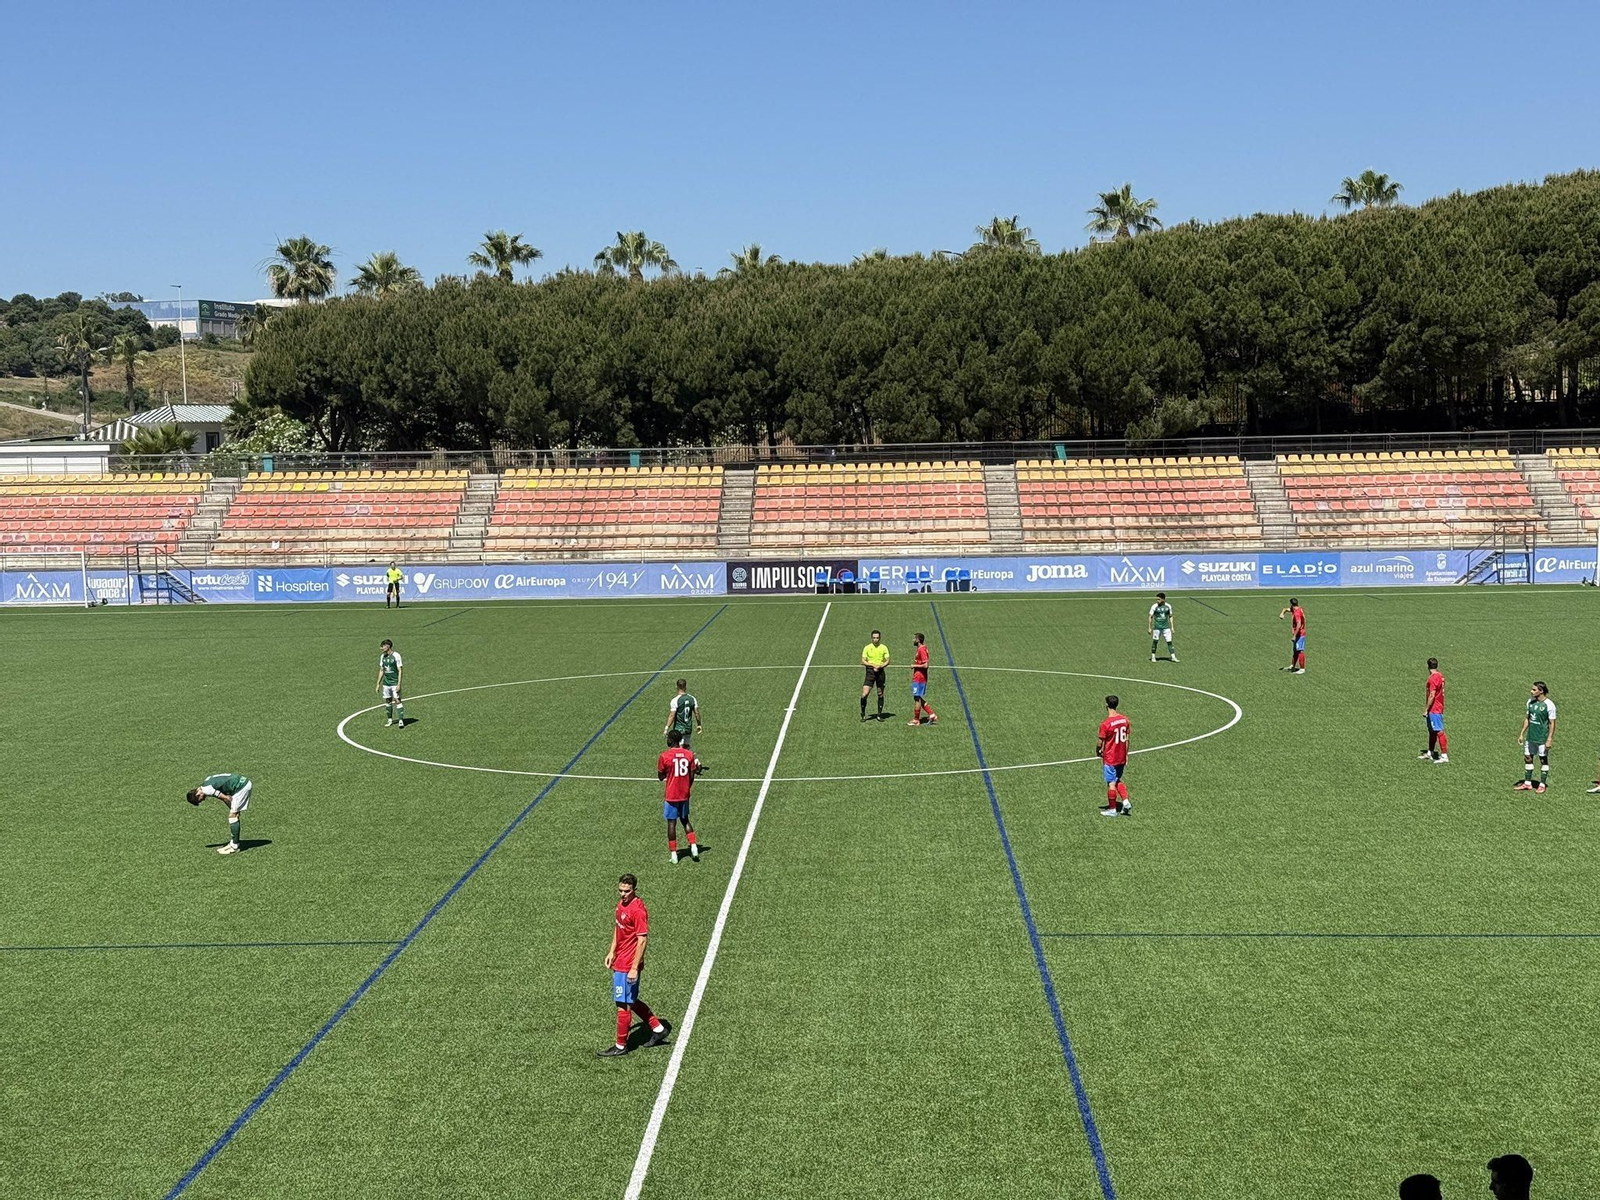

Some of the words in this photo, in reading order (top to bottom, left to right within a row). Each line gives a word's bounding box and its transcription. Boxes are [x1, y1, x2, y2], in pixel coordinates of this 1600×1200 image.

[1198, 561, 1256, 573] SUZUKI
[1350, 563, 1373, 573] azul
[1376, 562, 1415, 573] marino
[352, 574, 408, 586] SUZI
[969, 569, 1014, 581] irEuropa
[1110, 567, 1165, 583] MXM
[1201, 574, 1230, 582] PLAYCAR
[1231, 573, 1252, 582] COSTA
[1394, 572, 1414, 580] viajes
[276, 580, 329, 594] Hospiten
[515, 576, 567, 588] AirEuropa
[661, 574, 713, 590] MXM
[16, 583, 70, 599] MXM
[356, 587, 384, 595] PLAYCAR
[1113, 726, 1127, 744] 16
[672, 758, 689, 777] 18
